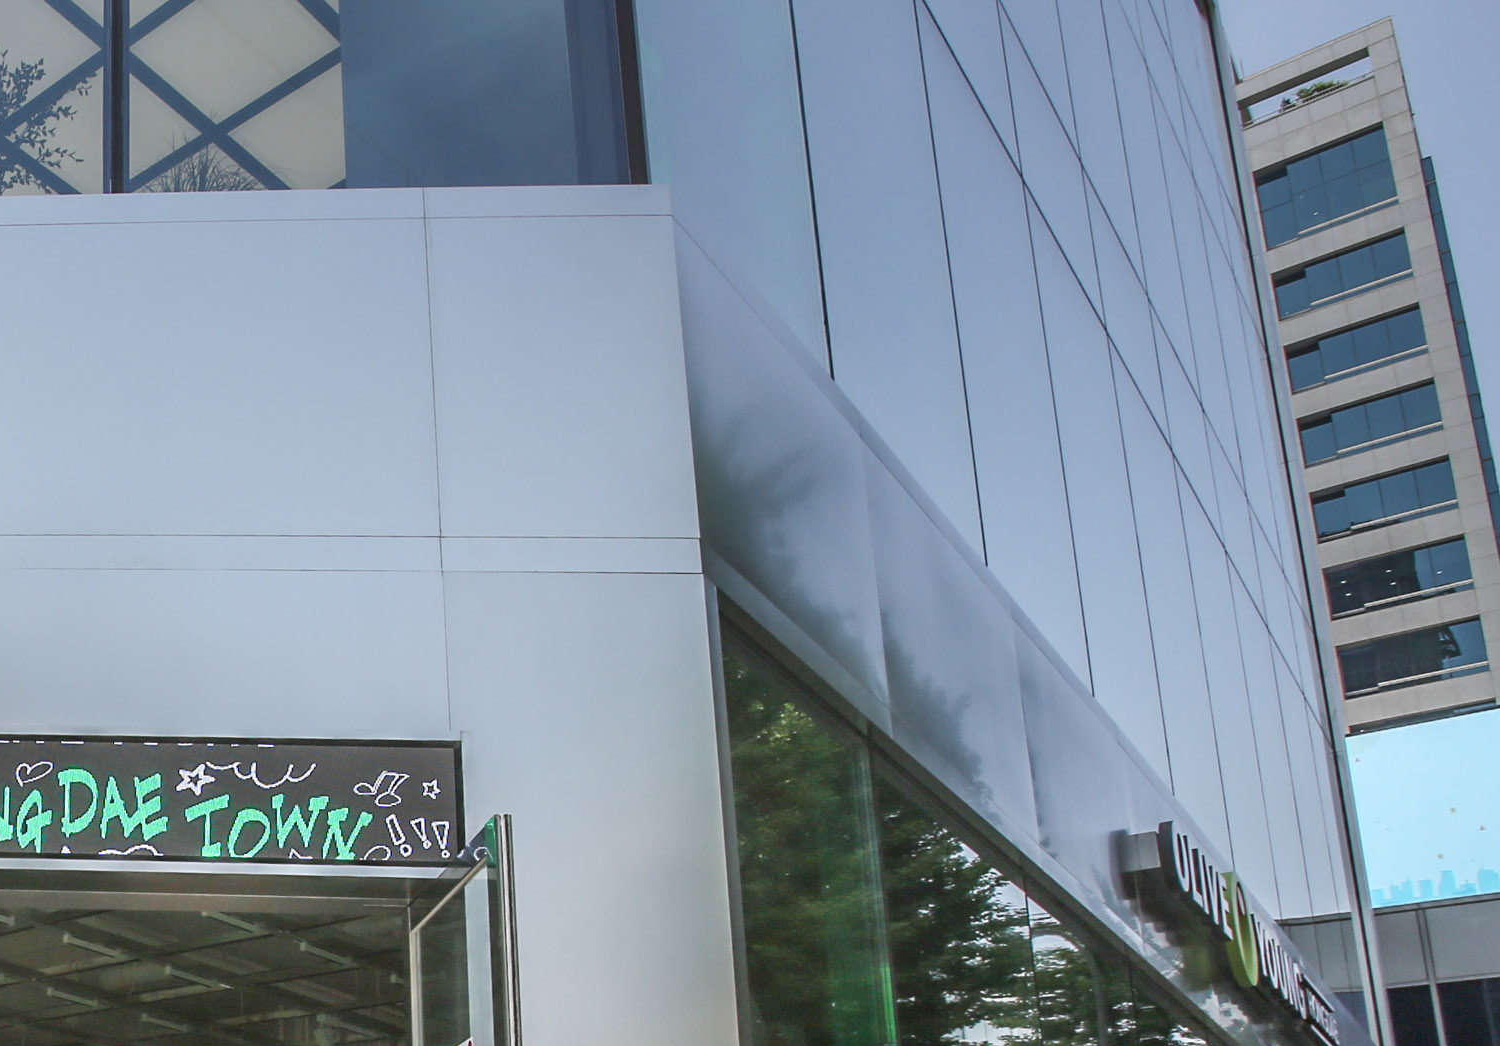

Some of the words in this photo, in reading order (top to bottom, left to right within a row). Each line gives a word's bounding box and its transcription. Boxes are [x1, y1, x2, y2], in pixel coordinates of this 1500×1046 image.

[184, 794, 374, 860] TOWN
[1172, 820, 1234, 941] OLIVE
[1250, 911, 1307, 1020] YOUNG
